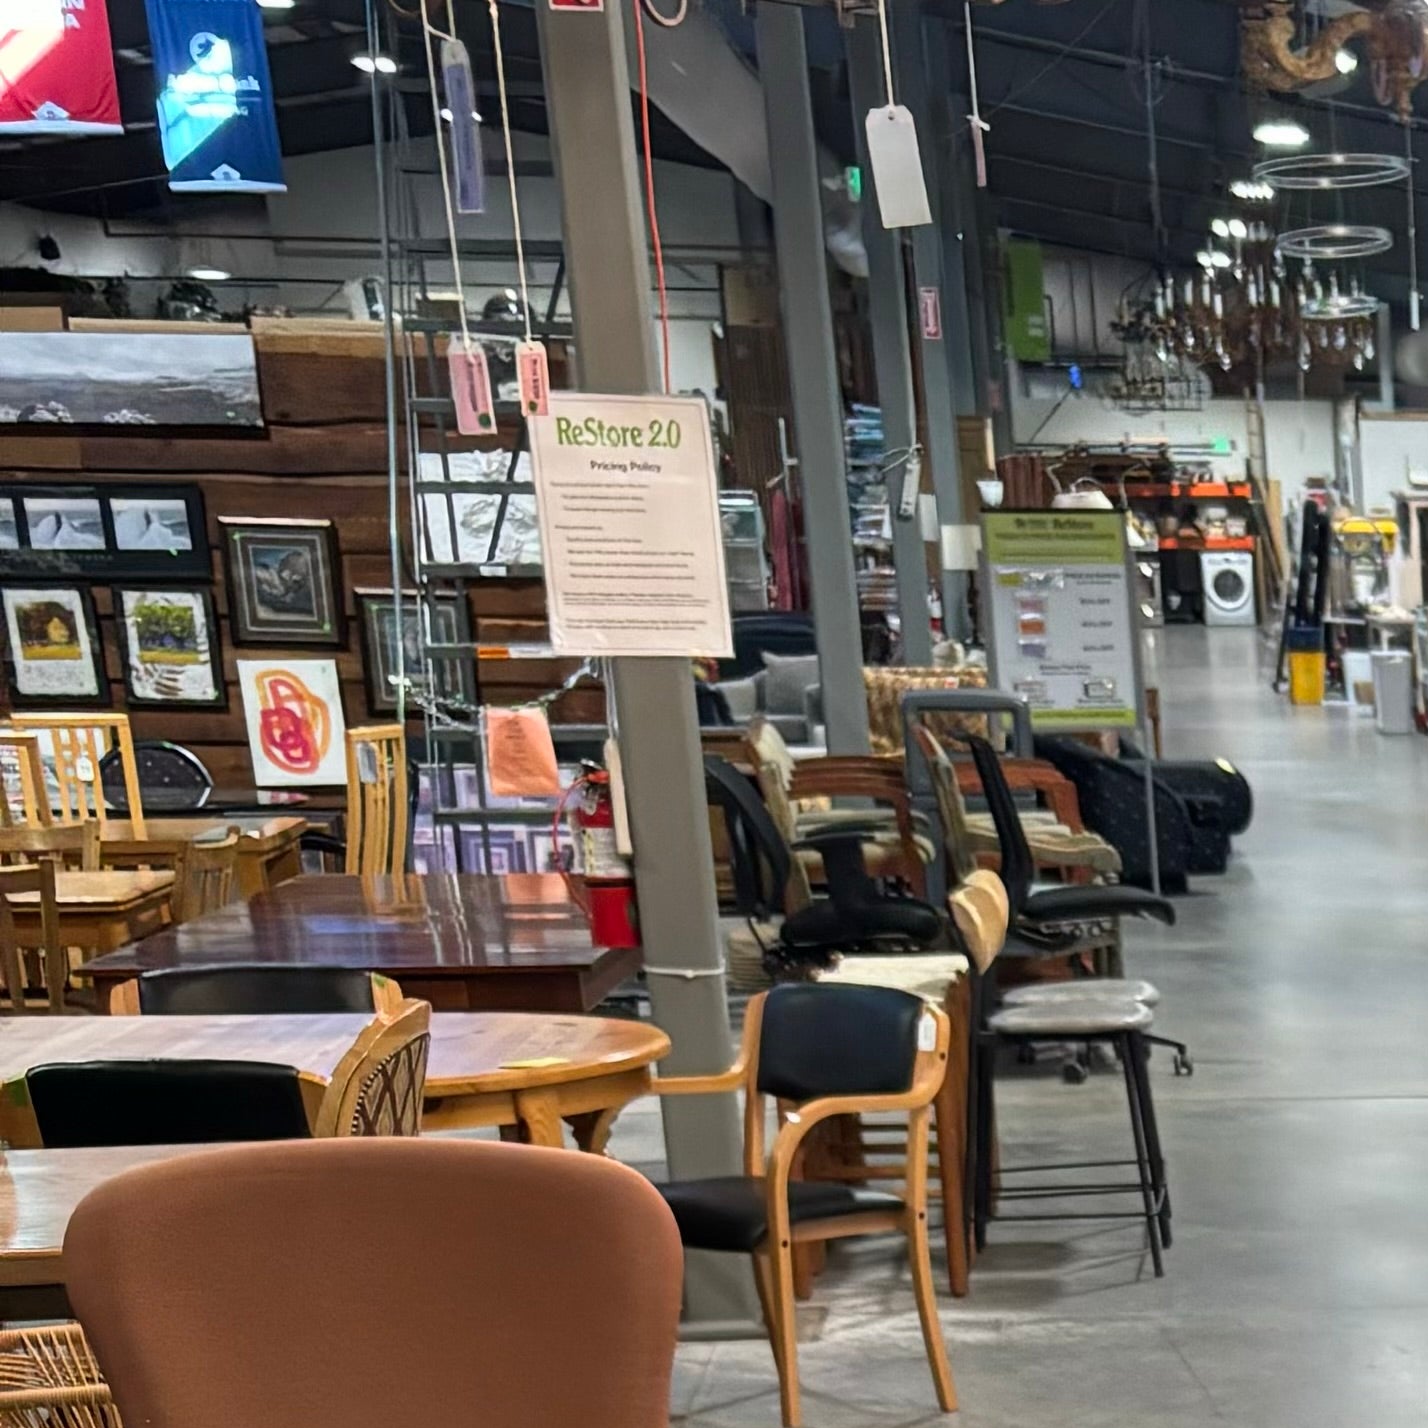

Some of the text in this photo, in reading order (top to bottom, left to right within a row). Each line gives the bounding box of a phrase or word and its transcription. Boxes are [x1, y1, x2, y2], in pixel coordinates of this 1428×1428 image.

[556, 417, 681, 449] ReStore 2.0
[590, 460, 661, 474] Pricing Policy
